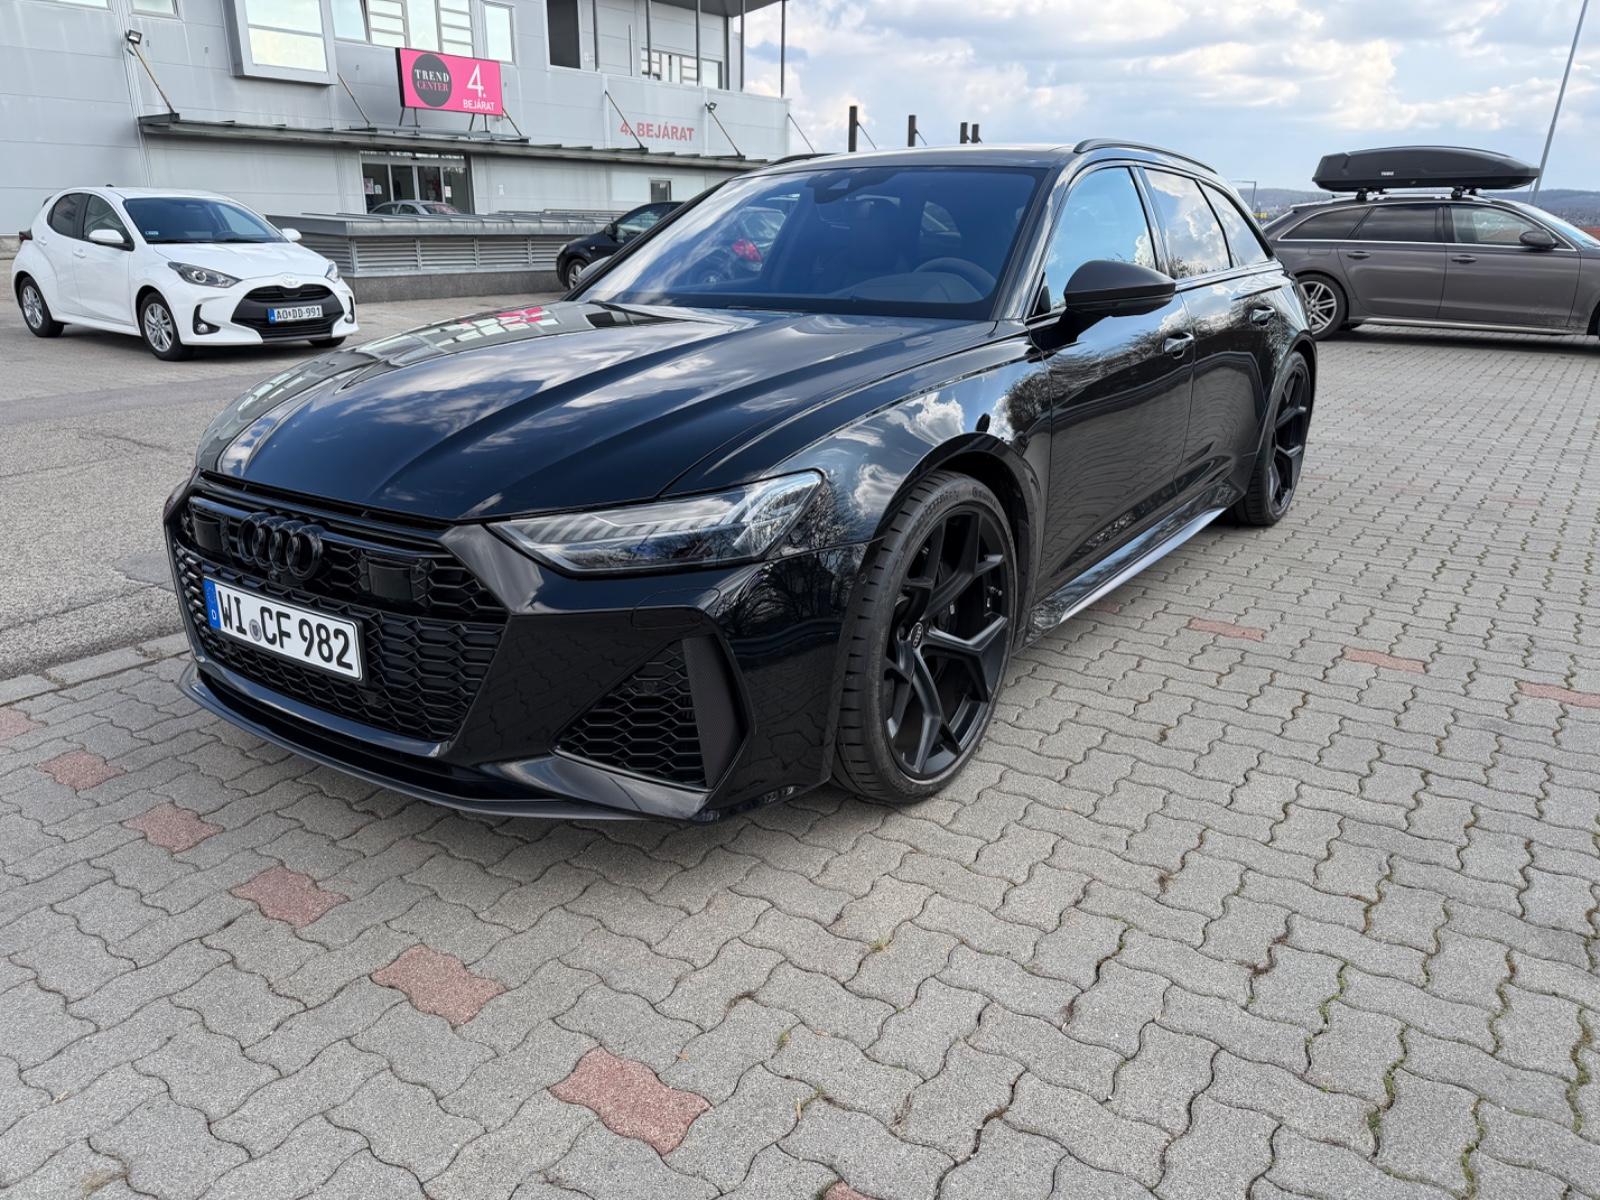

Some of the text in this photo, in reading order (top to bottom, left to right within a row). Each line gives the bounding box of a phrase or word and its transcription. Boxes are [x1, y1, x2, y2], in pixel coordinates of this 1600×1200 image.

[414, 69, 449, 82] TREND
[466, 63, 487, 98] 4.
[416, 80, 449, 91] CENTER
[462, 98, 495, 111] BEJÁRAT
[636, 122, 695, 142] BEJÁRAT
[218, 590, 354, 671] WI CF 982
